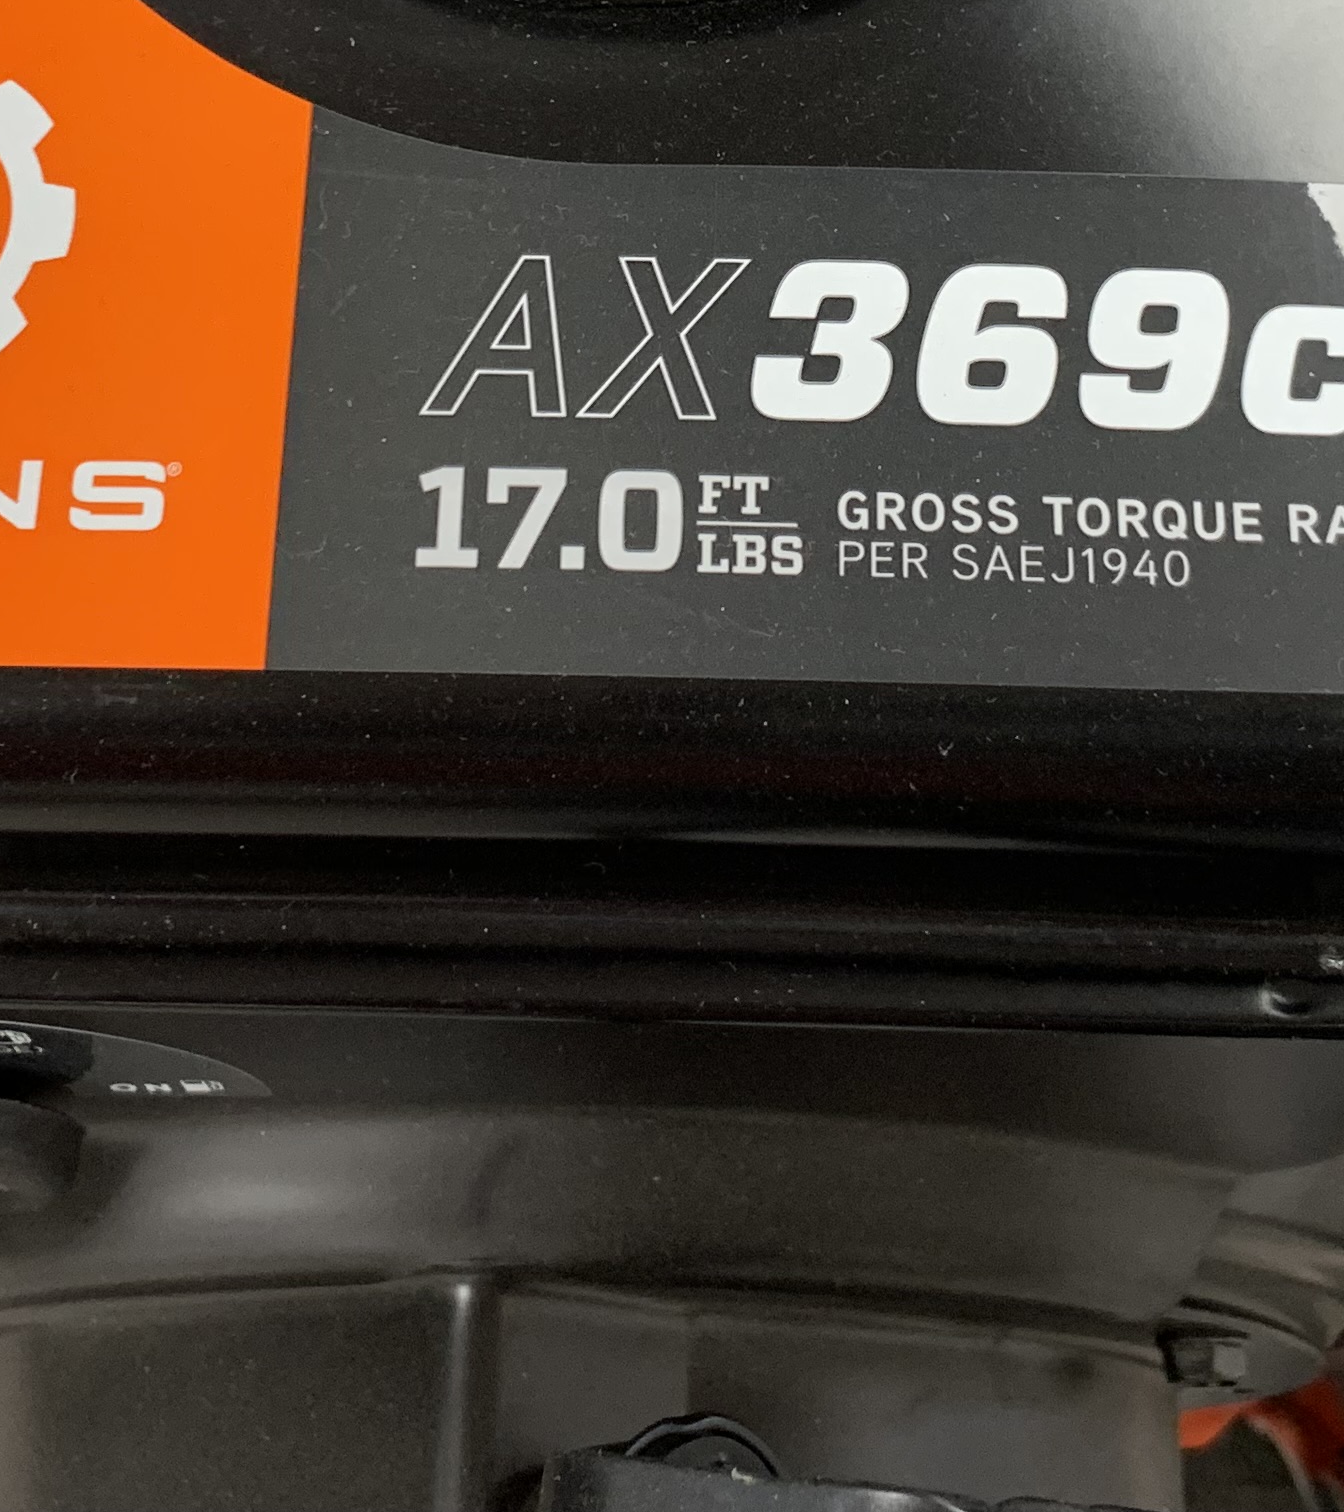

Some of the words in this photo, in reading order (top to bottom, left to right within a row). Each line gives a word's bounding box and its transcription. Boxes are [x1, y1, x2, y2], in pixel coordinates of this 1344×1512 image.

[697, 474, 772, 516] FT
[836, 490, 1020, 537] GROSS
[1043, 496, 1264, 543] TORQUE
[414, 465, 684, 573] 17.0
[696, 534, 804, 578] LBS
[836, 541, 936, 580] PER
[108, 1081, 174, 1095] ON
